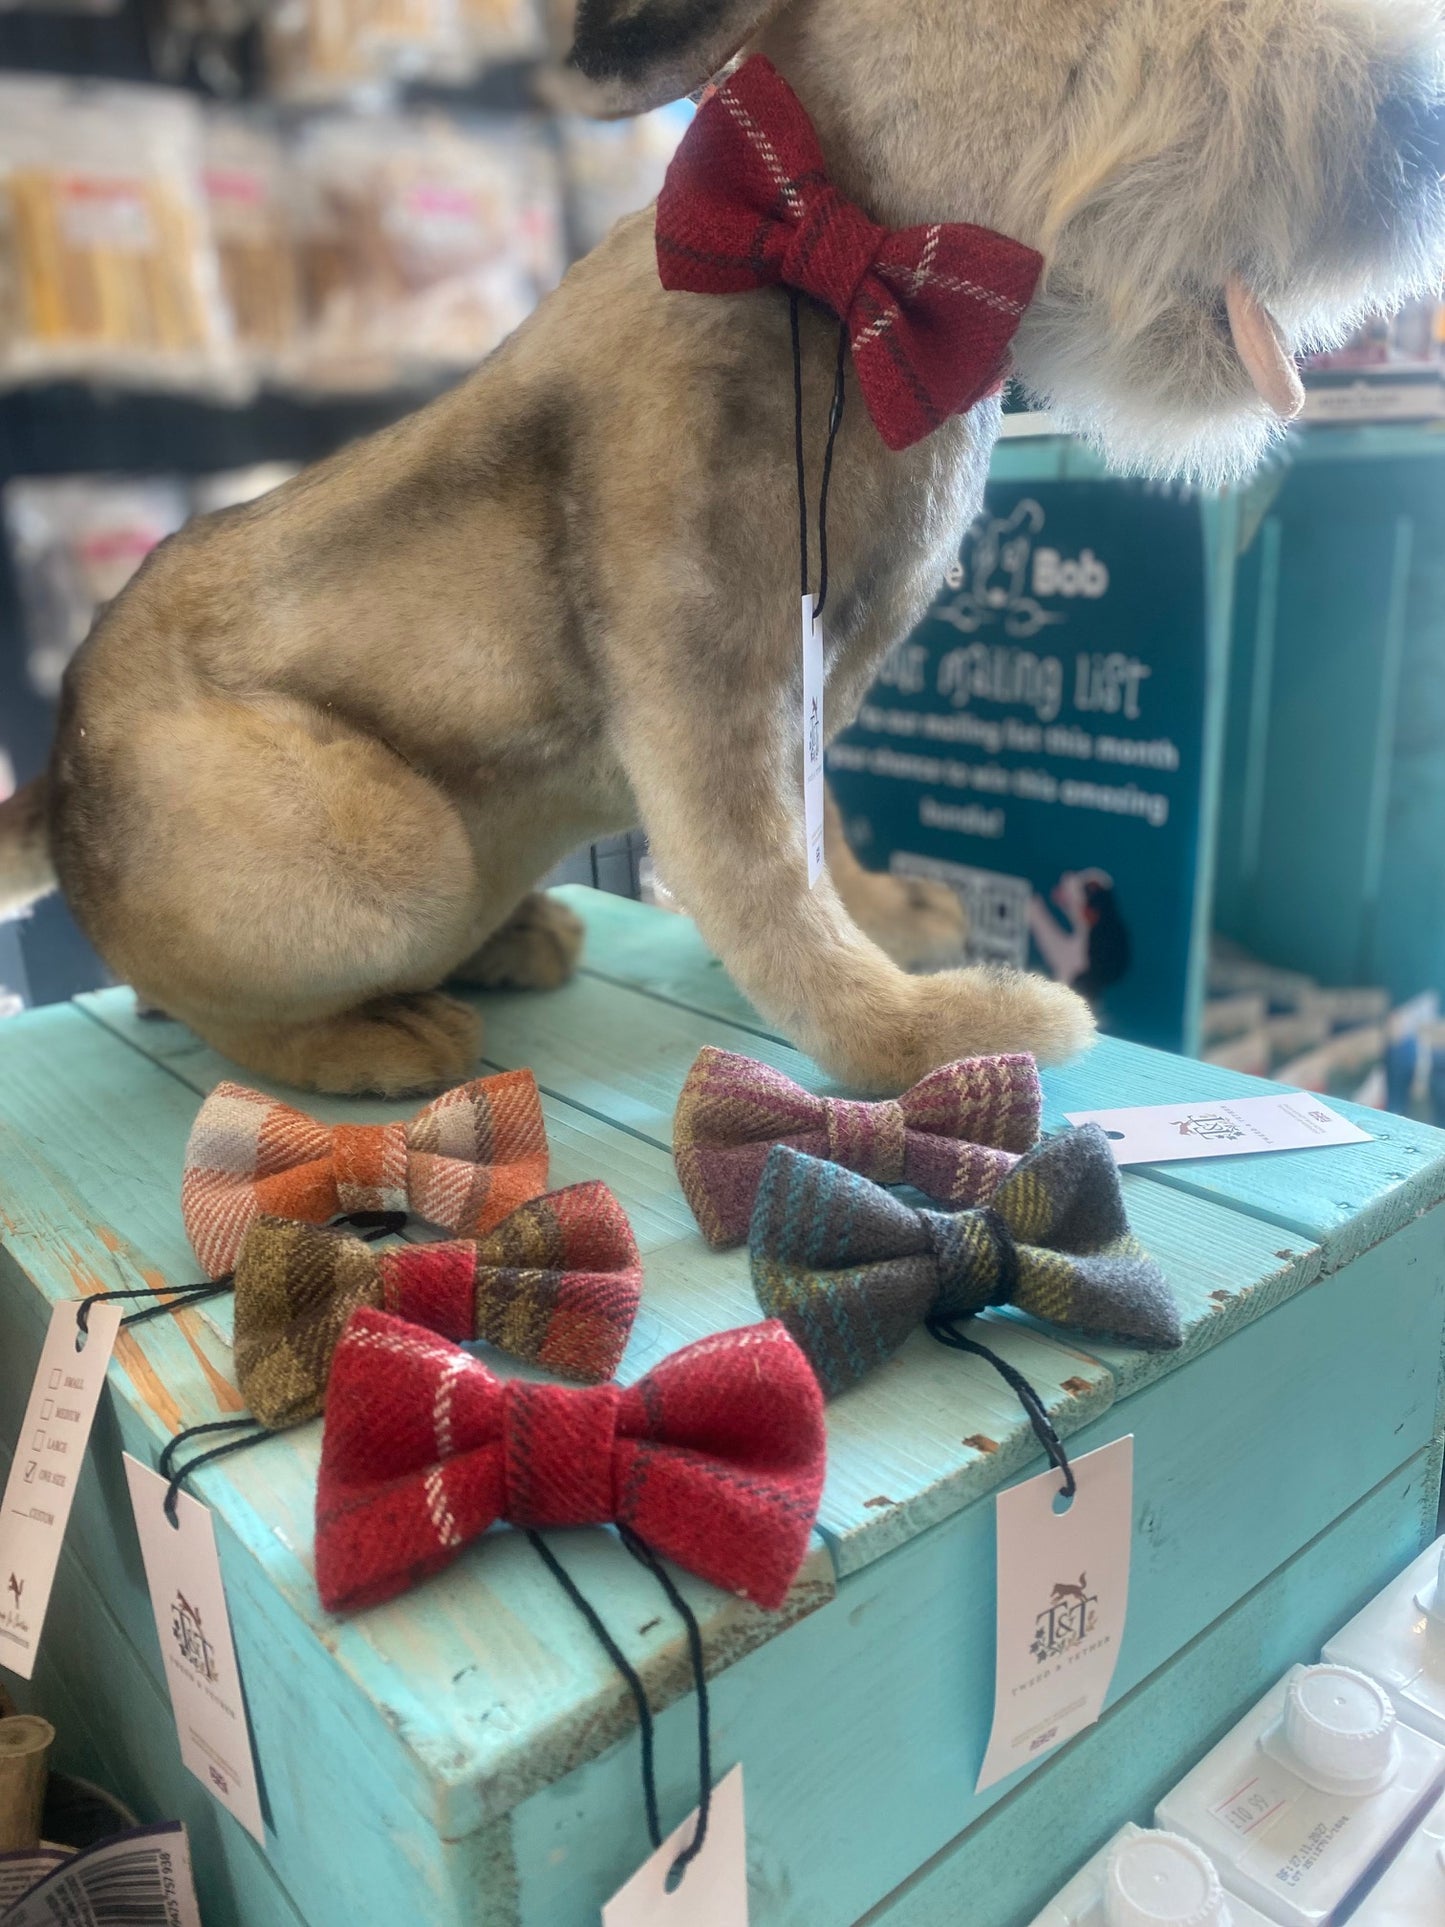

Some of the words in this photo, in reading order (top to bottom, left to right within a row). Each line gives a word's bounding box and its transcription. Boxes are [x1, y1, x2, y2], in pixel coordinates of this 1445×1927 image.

[1032, 547, 1109, 597] Bob
[1044, 724, 1092, 759] this
[1095, 734, 1179, 771] month
[1059, 780, 1168, 827] amazing
[1036, 1595, 1098, 1647] T&T
[1011, 1670, 1051, 1697] TWEED
[1068, 1635, 1112, 1665] TETHER
